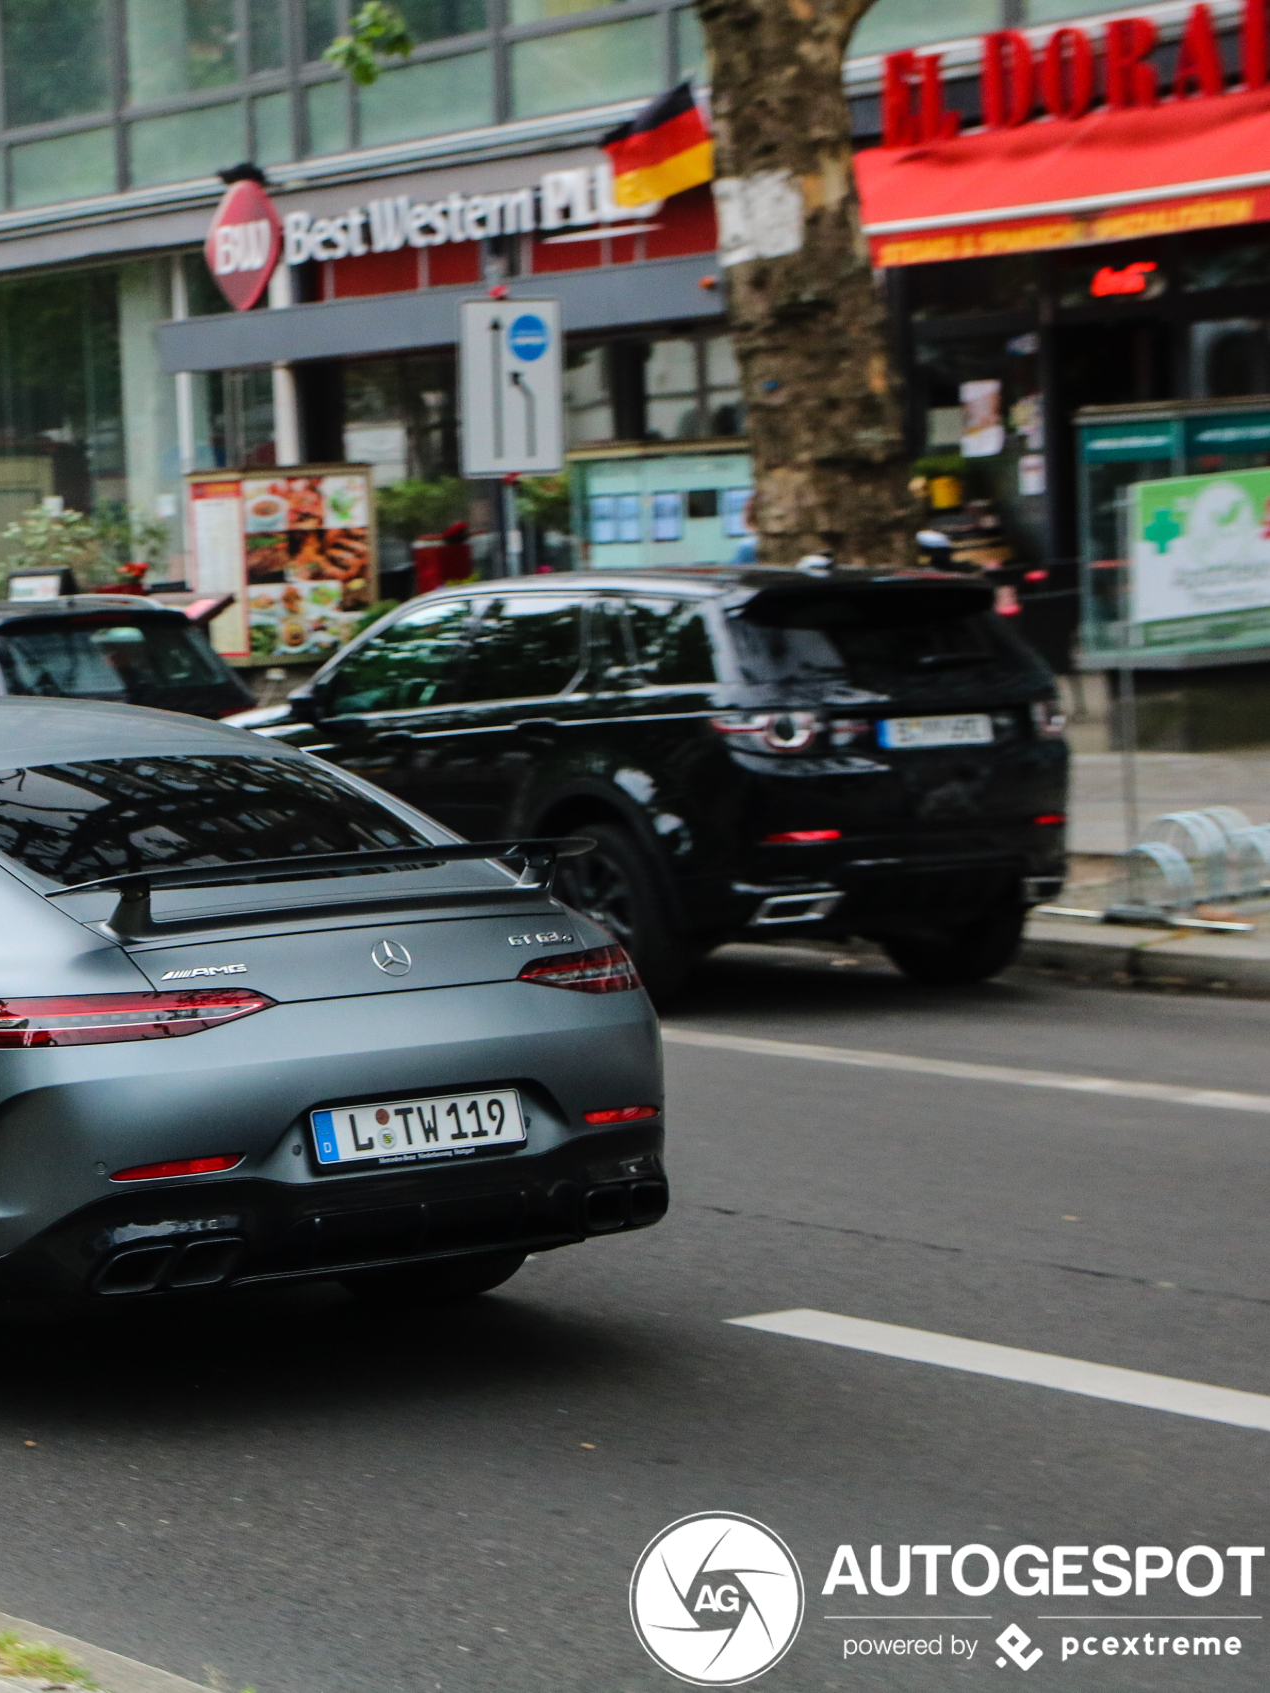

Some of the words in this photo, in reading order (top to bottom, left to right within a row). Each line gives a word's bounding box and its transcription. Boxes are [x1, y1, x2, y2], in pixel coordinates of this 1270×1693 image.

[882, 49, 960, 147] EL
[190, 963, 248, 979] AMG
[323, 1142, 333, 1154] D
[349, 1113, 375, 1152] L
